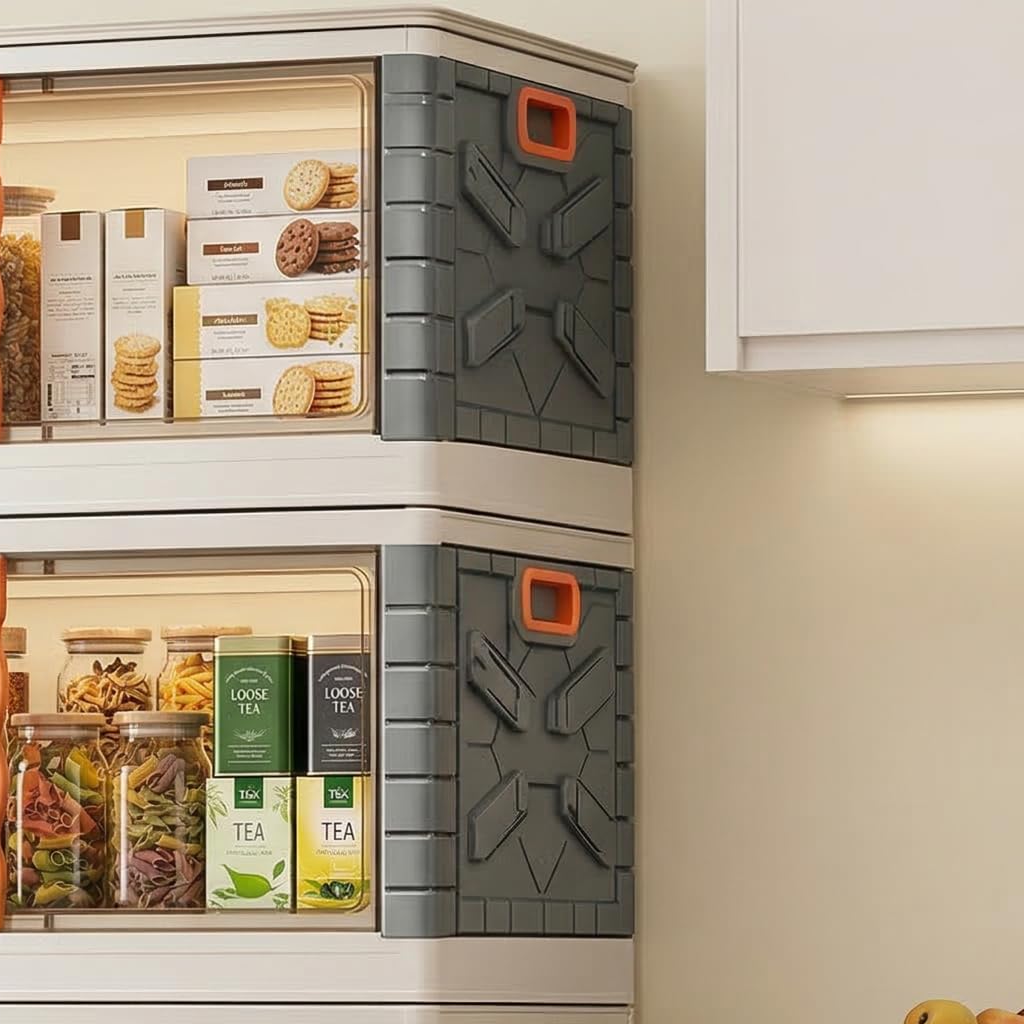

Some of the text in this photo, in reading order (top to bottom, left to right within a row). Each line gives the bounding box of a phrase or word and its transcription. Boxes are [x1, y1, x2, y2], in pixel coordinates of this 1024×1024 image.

[230, 688, 270, 701] LOOSE
[324, 686, 364, 700] LOOSE
[238, 702, 261, 715] TEA
[332, 700, 356, 714] TEA
[232, 822, 265, 842] TEA
[321, 821, 356, 841] TEA
